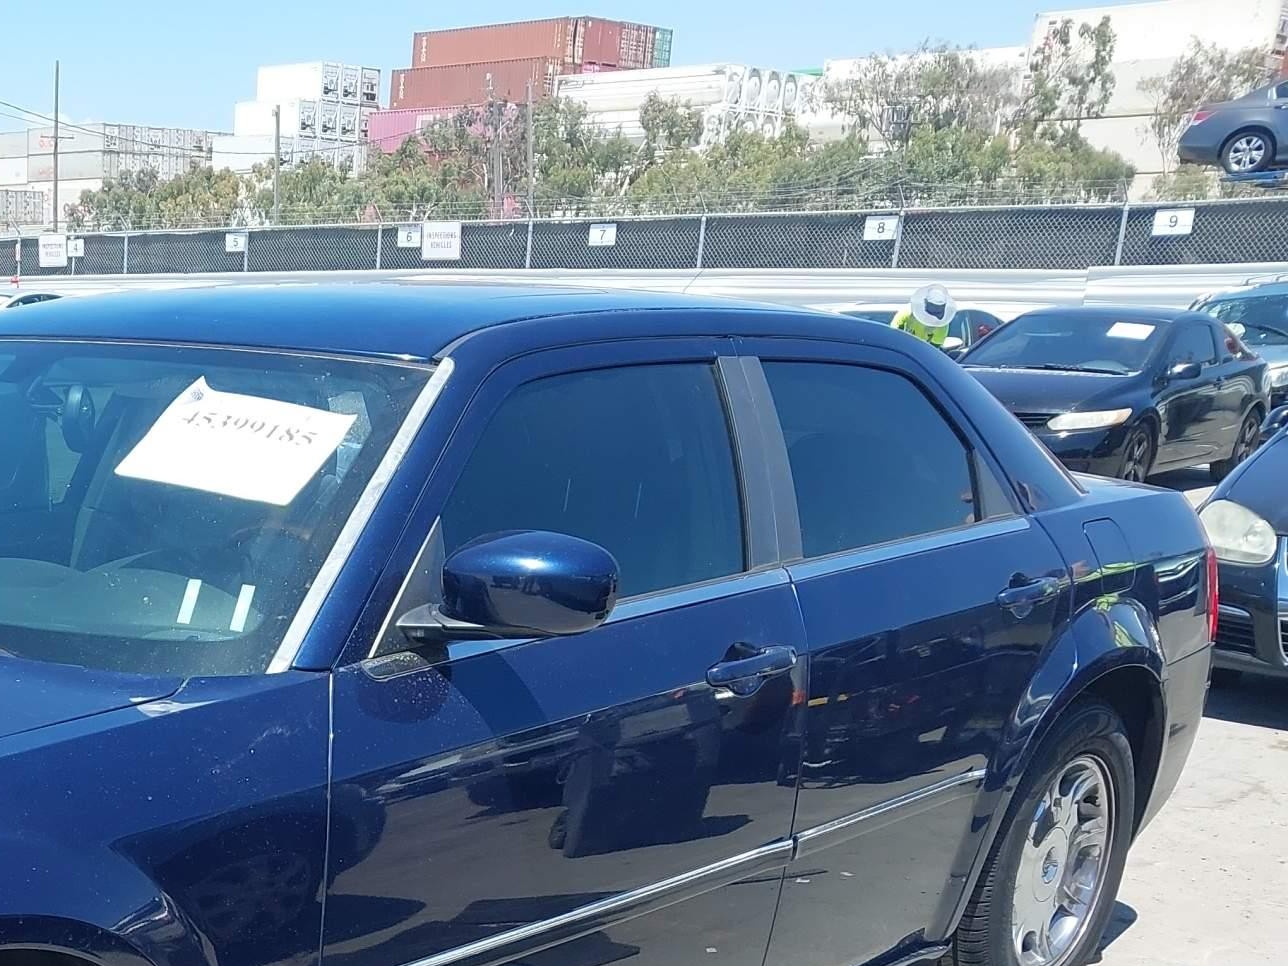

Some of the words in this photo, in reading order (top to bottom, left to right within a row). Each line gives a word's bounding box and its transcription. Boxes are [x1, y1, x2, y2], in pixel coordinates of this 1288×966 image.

[1169, 214, 1178, 228] 9
[877, 221, 886, 234] 8
[406, 231, 413, 242] 6
[599, 229, 607, 241] 7
[232, 237, 239, 247] 5
